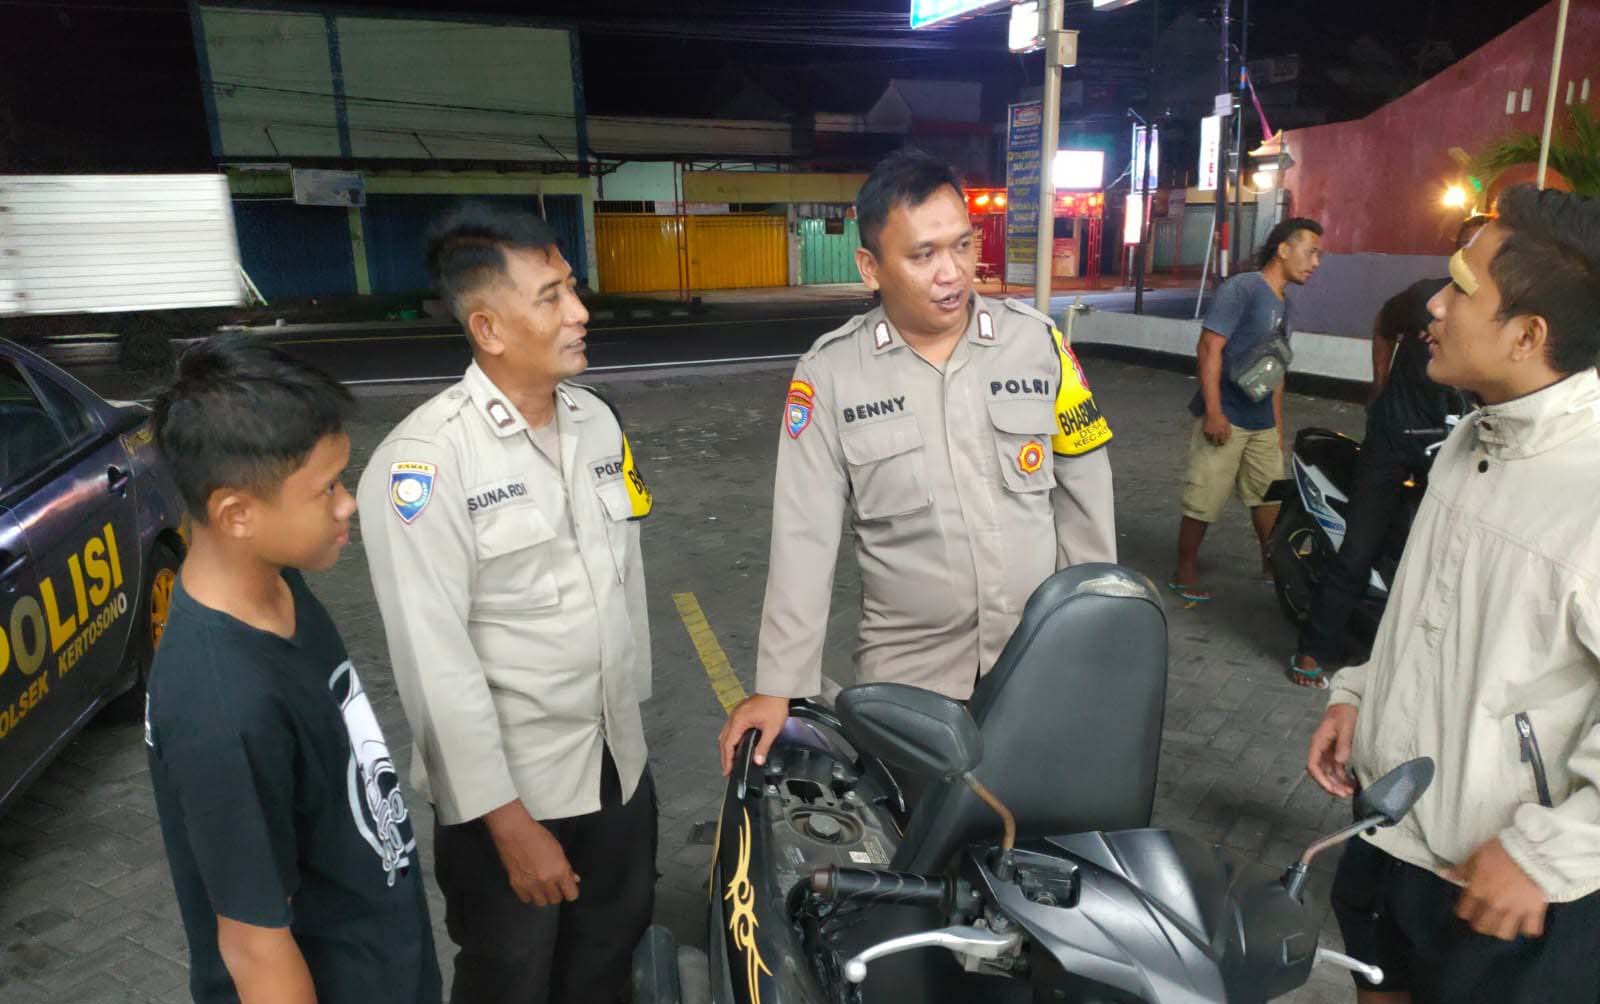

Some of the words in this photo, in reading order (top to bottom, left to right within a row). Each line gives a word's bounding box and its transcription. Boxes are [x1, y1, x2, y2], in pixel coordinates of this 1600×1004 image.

[990, 378, 1049, 396] POLRI
[843, 395, 905, 423] BENNY
[466, 482, 528, 511] SUNARDI
[57, 591, 128, 678] KERTOSONO
